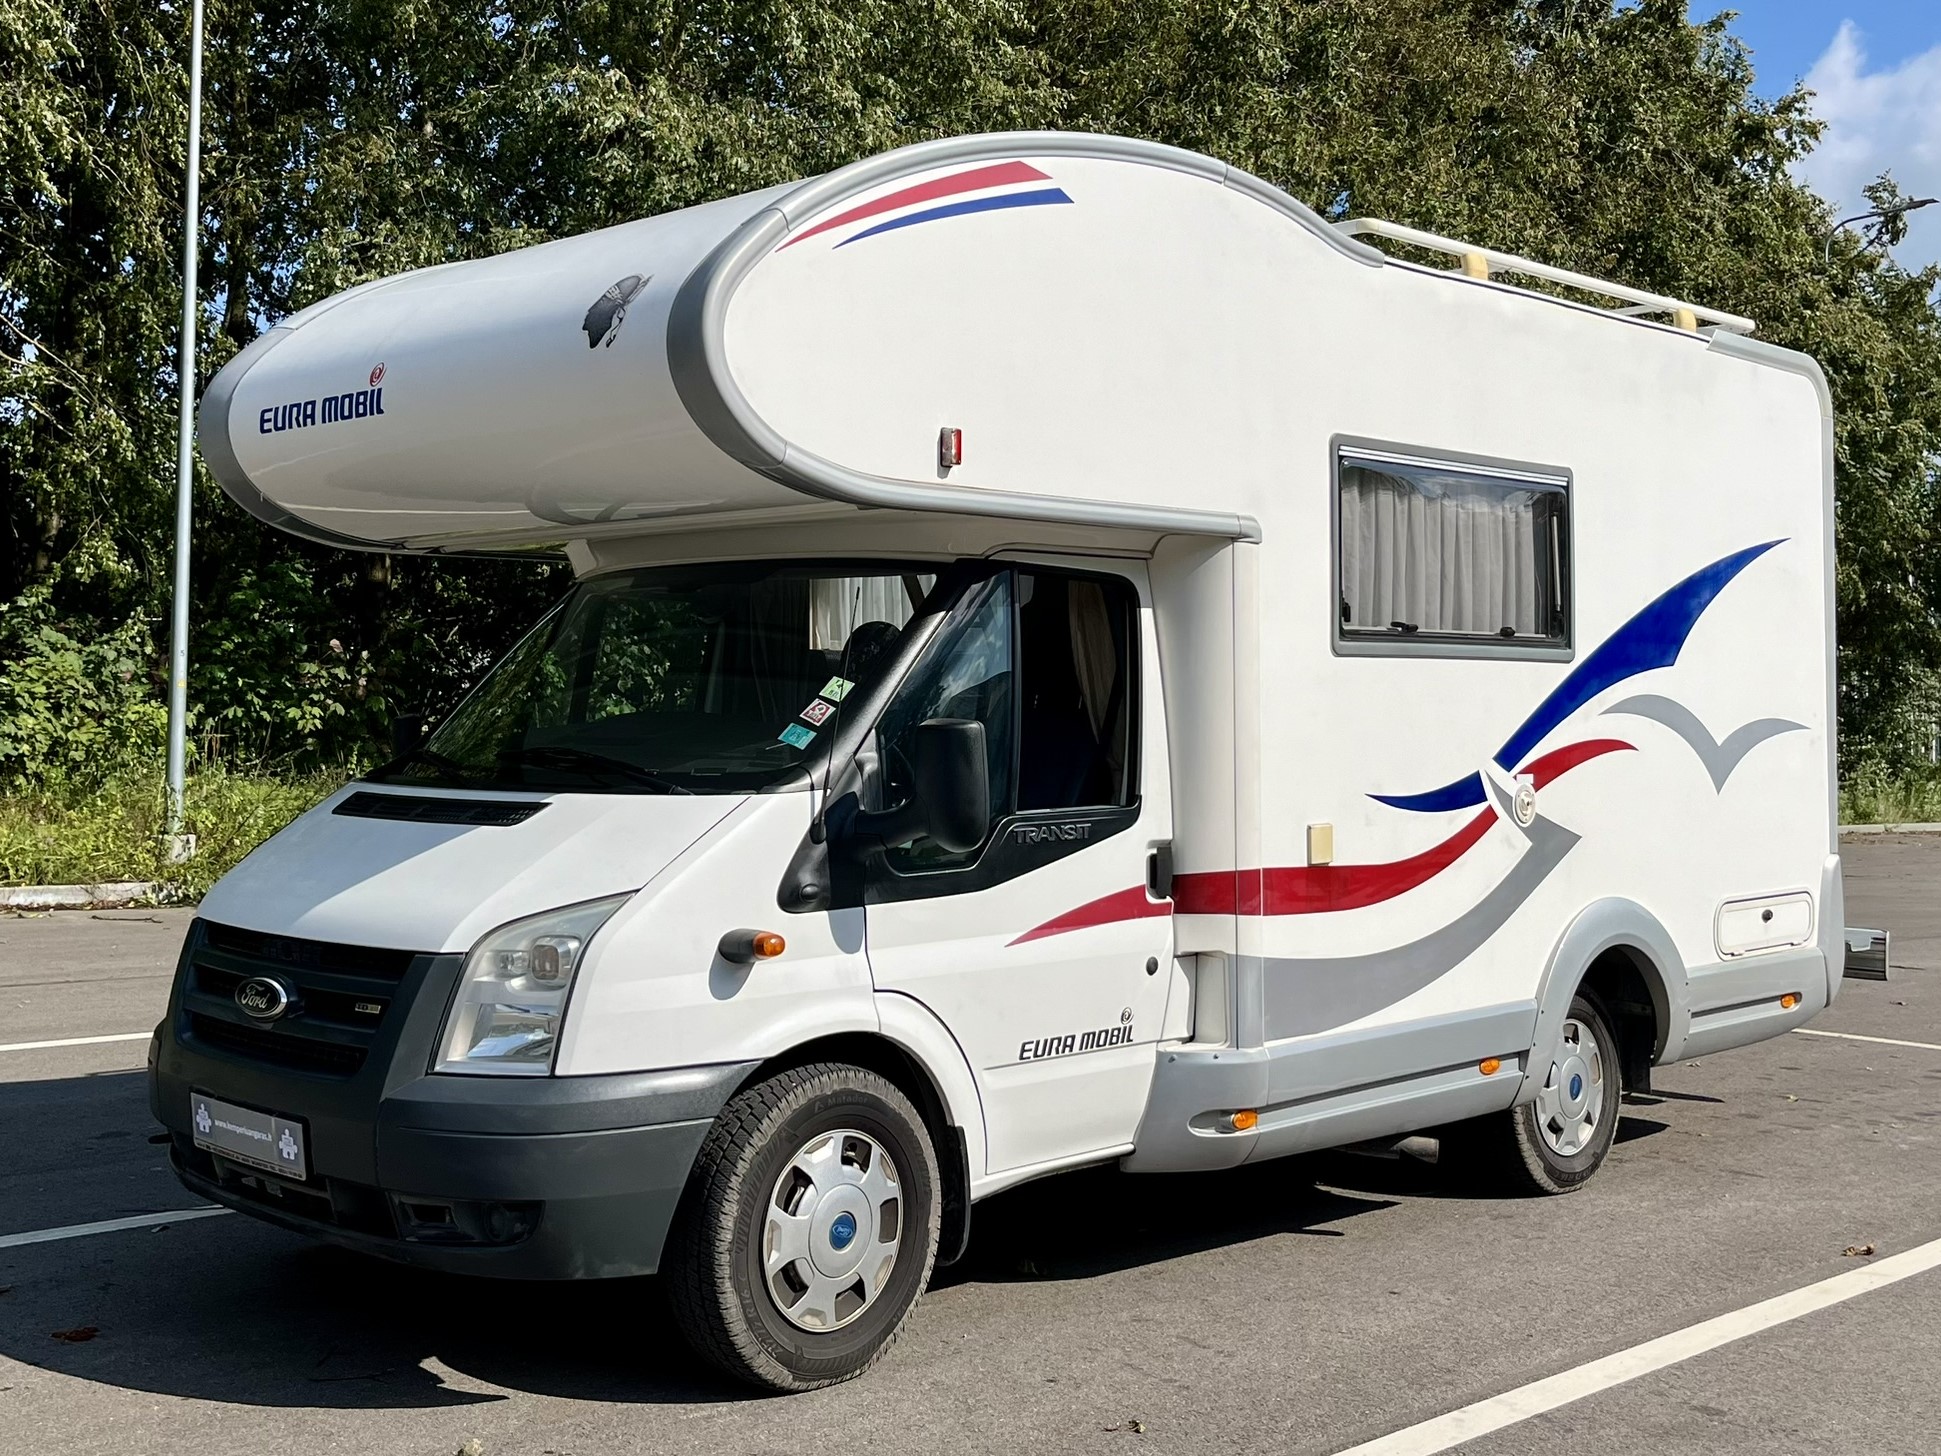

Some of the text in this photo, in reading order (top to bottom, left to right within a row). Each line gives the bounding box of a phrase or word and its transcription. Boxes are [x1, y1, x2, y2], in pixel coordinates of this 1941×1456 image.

[259, 387, 385, 435] EURA MOBIL
[1013, 823, 1092, 844] TRANSIT
[241, 983, 270, 1009] Ford
[1018, 1024, 1134, 1061] EURA MOBIL
